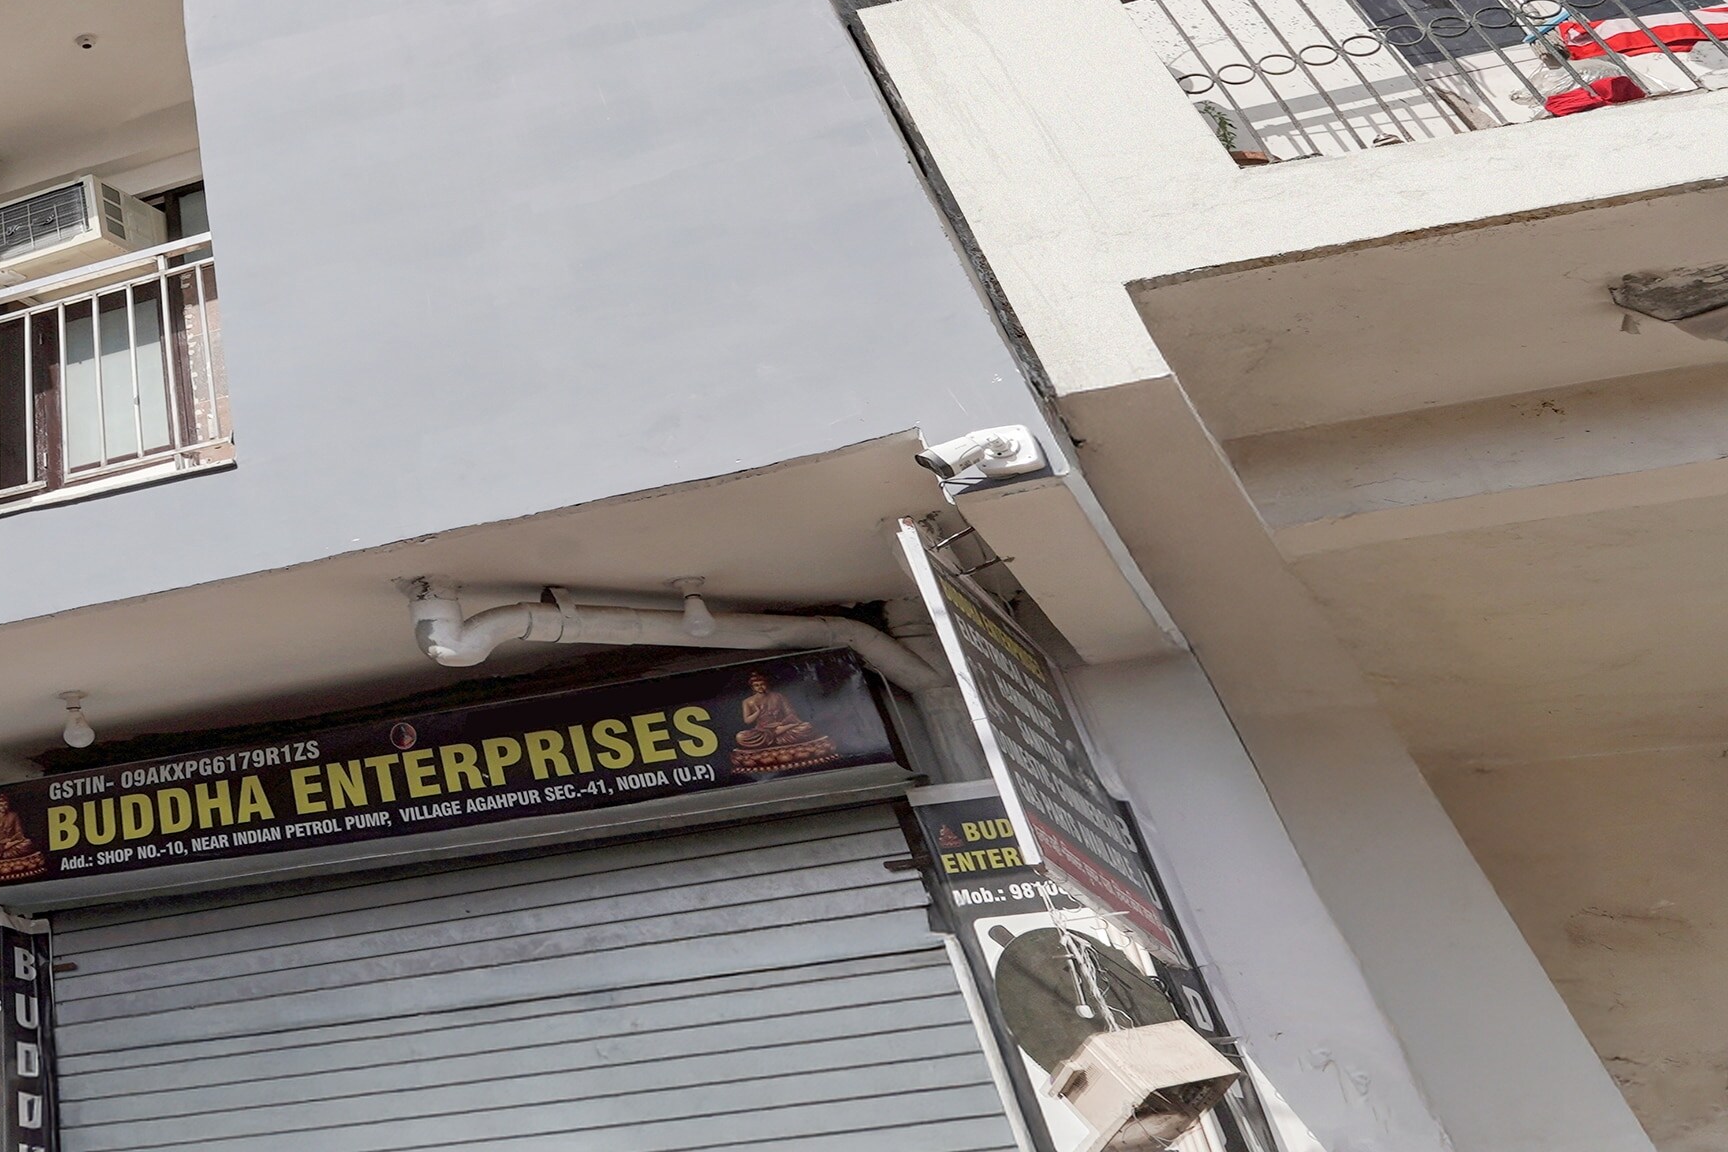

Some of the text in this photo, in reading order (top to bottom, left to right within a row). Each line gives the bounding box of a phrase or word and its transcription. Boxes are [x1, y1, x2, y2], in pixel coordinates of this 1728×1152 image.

[47, 705, 719, 852] BUDDHA ENTERPRISES
[48, 774, 115, 802] GSTIN-
[60, 855, 94, 872] Add.:
[97, 848, 134, 867] SHOP
[191, 834, 230, 853] NEAR
[233, 827, 282, 847] INDIAN
[285, 819, 342, 839] PETROL
[345, 811, 392, 829] PUMP,
[399, 801, 462, 823] VILLAGE
[466, 790, 542, 814] AGAHPUR
[616, 771, 669, 793] NOIDA
[672, 763, 716, 787] (U.P.)
[952, 886, 1007, 908] Mob.:
